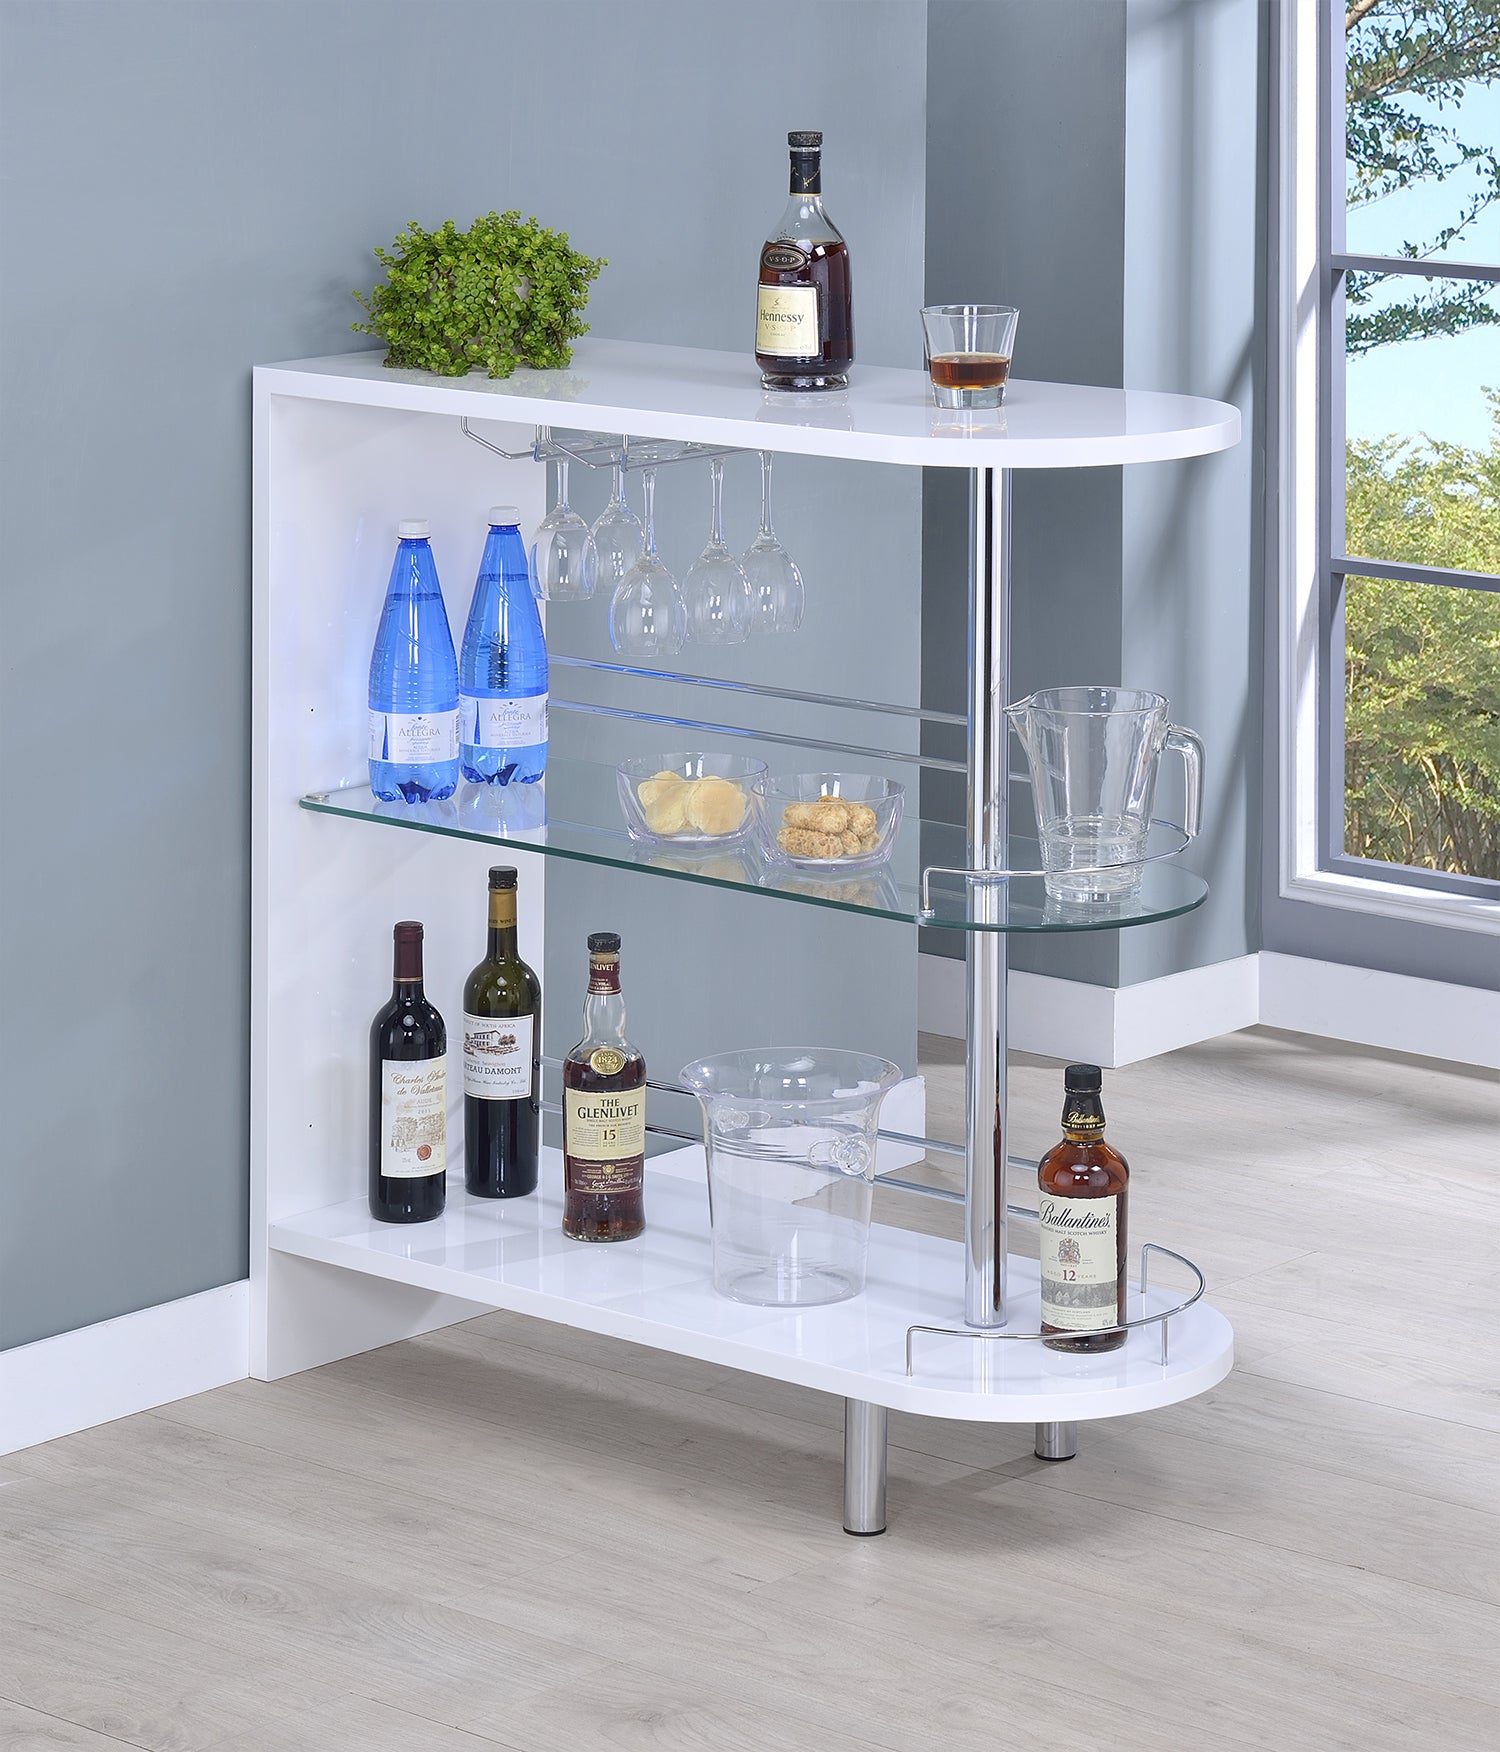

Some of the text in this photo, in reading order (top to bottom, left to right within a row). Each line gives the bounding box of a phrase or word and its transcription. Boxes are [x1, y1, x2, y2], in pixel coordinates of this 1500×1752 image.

[760, 309, 805, 325] Hennessy
[490, 713, 532, 721] ALLEGRA
[399, 728, 441, 737] ALLEGRA
[598, 1055, 619, 1064] 1824
[484, 1066, 522, 1075] DAMONT
[390, 1072, 424, 1085] Charles
[396, 1087, 408, 1096] de
[600, 1099, 620, 1108] THE
[578, 1104, 638, 1119] GLENLIVET
[603, 1129, 617, 1141] 15
[1040, 1200, 1111, 1229] Ballantine's
[1062, 1269, 1077, 1281] 12
